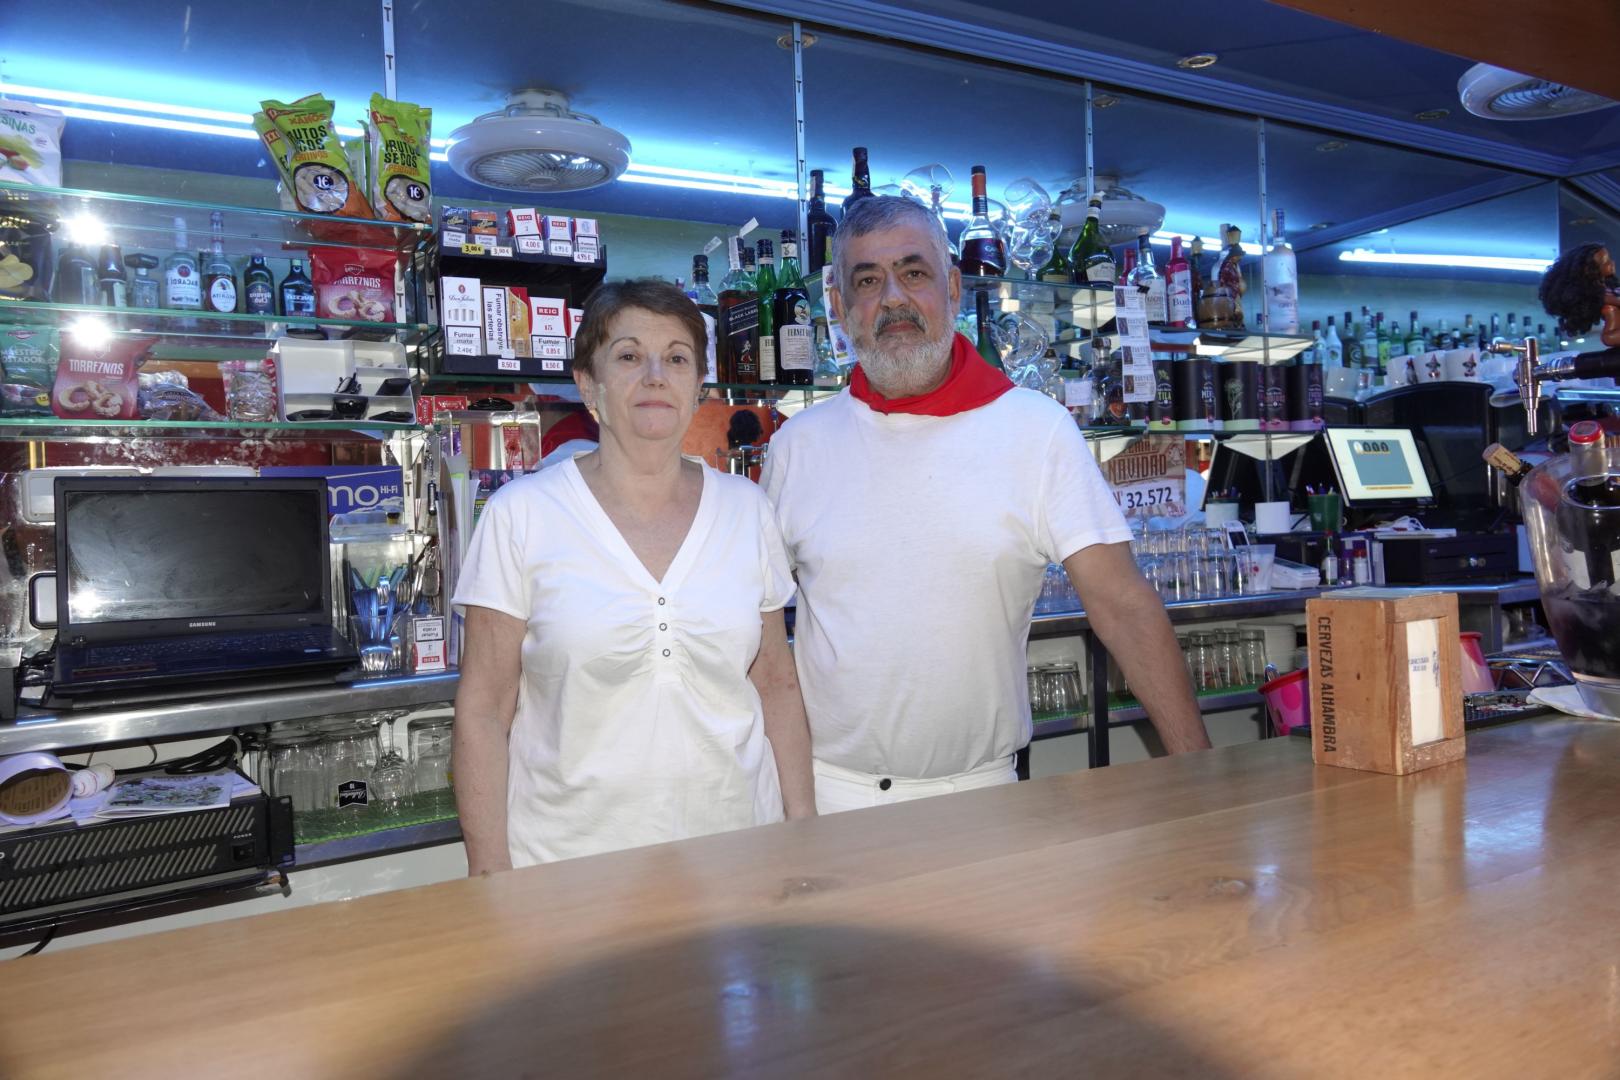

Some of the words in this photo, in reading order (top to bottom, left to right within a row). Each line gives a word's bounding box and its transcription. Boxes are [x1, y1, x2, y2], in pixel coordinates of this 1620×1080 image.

[69, 359, 125, 375] TORREZNOS
[1109, 454, 1167, 484] NAVIDAD
[380, 485, 398, 494] Hi-Fi
[1126, 486, 1173, 509] 32.572
[1317, 616, 1334, 678] CERVEZAS
[1321, 683, 1337, 752] ALHAMBRA
